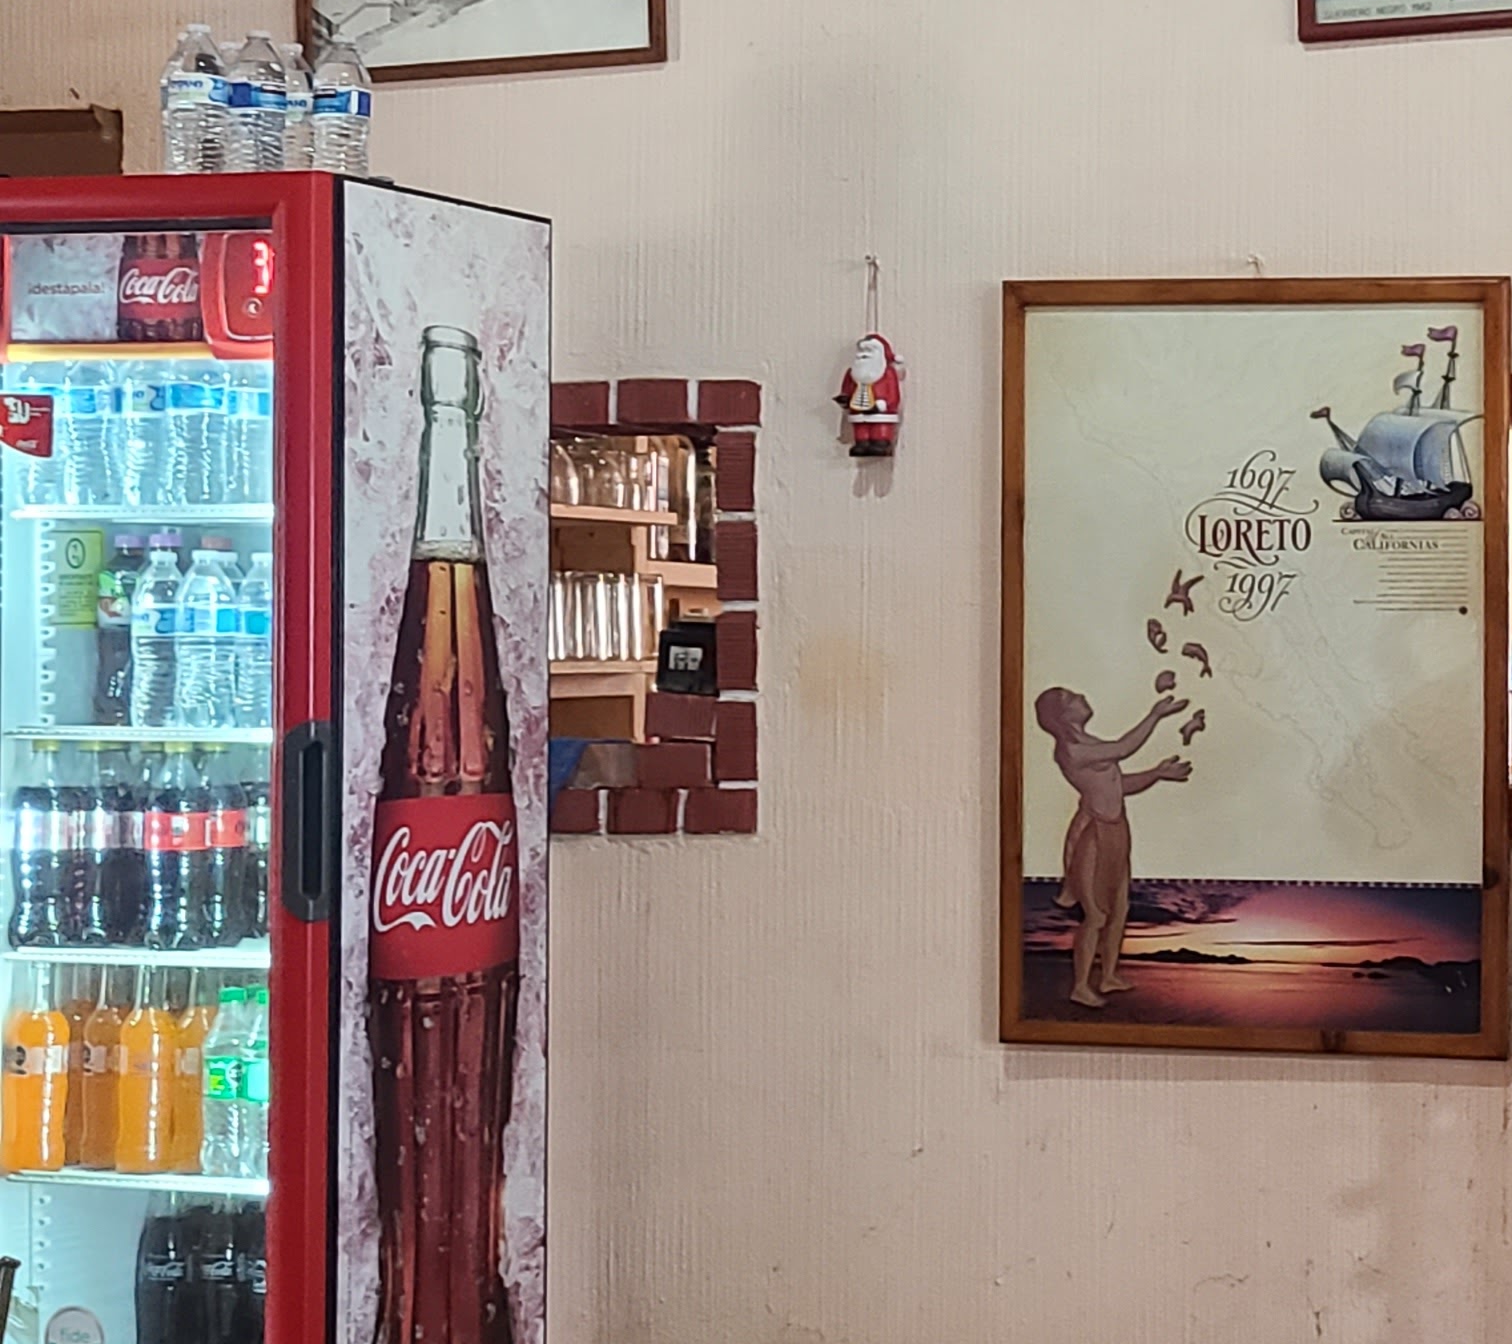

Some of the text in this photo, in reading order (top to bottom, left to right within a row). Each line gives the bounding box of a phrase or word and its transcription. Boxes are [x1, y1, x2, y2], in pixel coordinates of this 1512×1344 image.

[1224, 450, 1297, 515] 1697
[1197, 514, 1312, 566] LORETO
[1353, 538, 1440, 551] CALIFORNIAS
[1218, 572, 1297, 622] 1997
[373, 819, 514, 934] Coca-Cola
